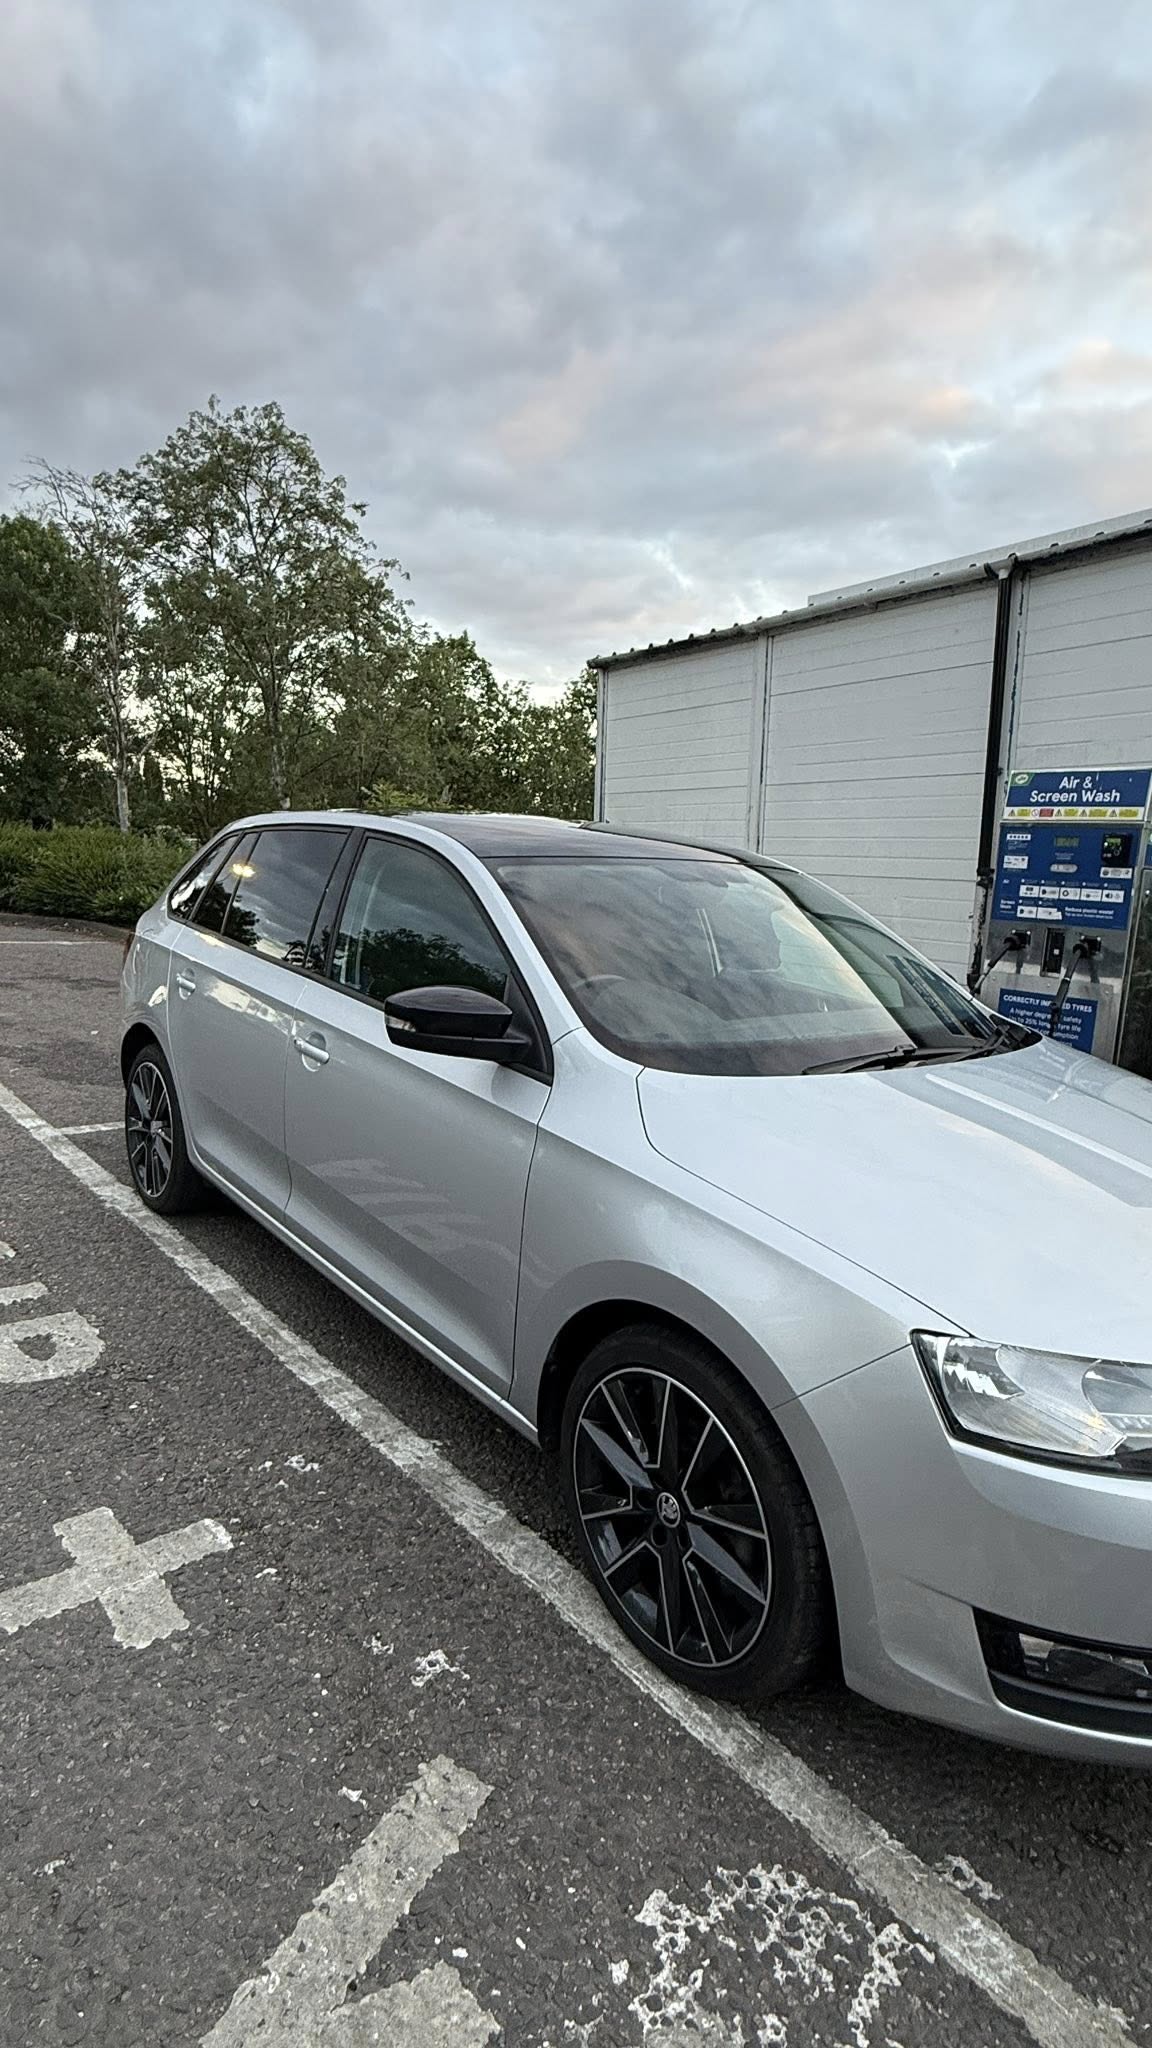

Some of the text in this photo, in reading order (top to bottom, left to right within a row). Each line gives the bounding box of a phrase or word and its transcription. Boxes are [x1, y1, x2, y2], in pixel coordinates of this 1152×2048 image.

[1059, 776, 1093, 789] Air &
[1030, 789, 1120, 803] Screen Wash
[1003, 994, 1040, 1006] CORRECTLY
[1072, 1003, 1093, 1013] TYRES
[1015, 1008, 1033, 1017] higher
[1063, 1015, 1082, 1024] safety
[1057, 1023, 1070, 1032] tyre
[1071, 1023, 1082, 1033] life
